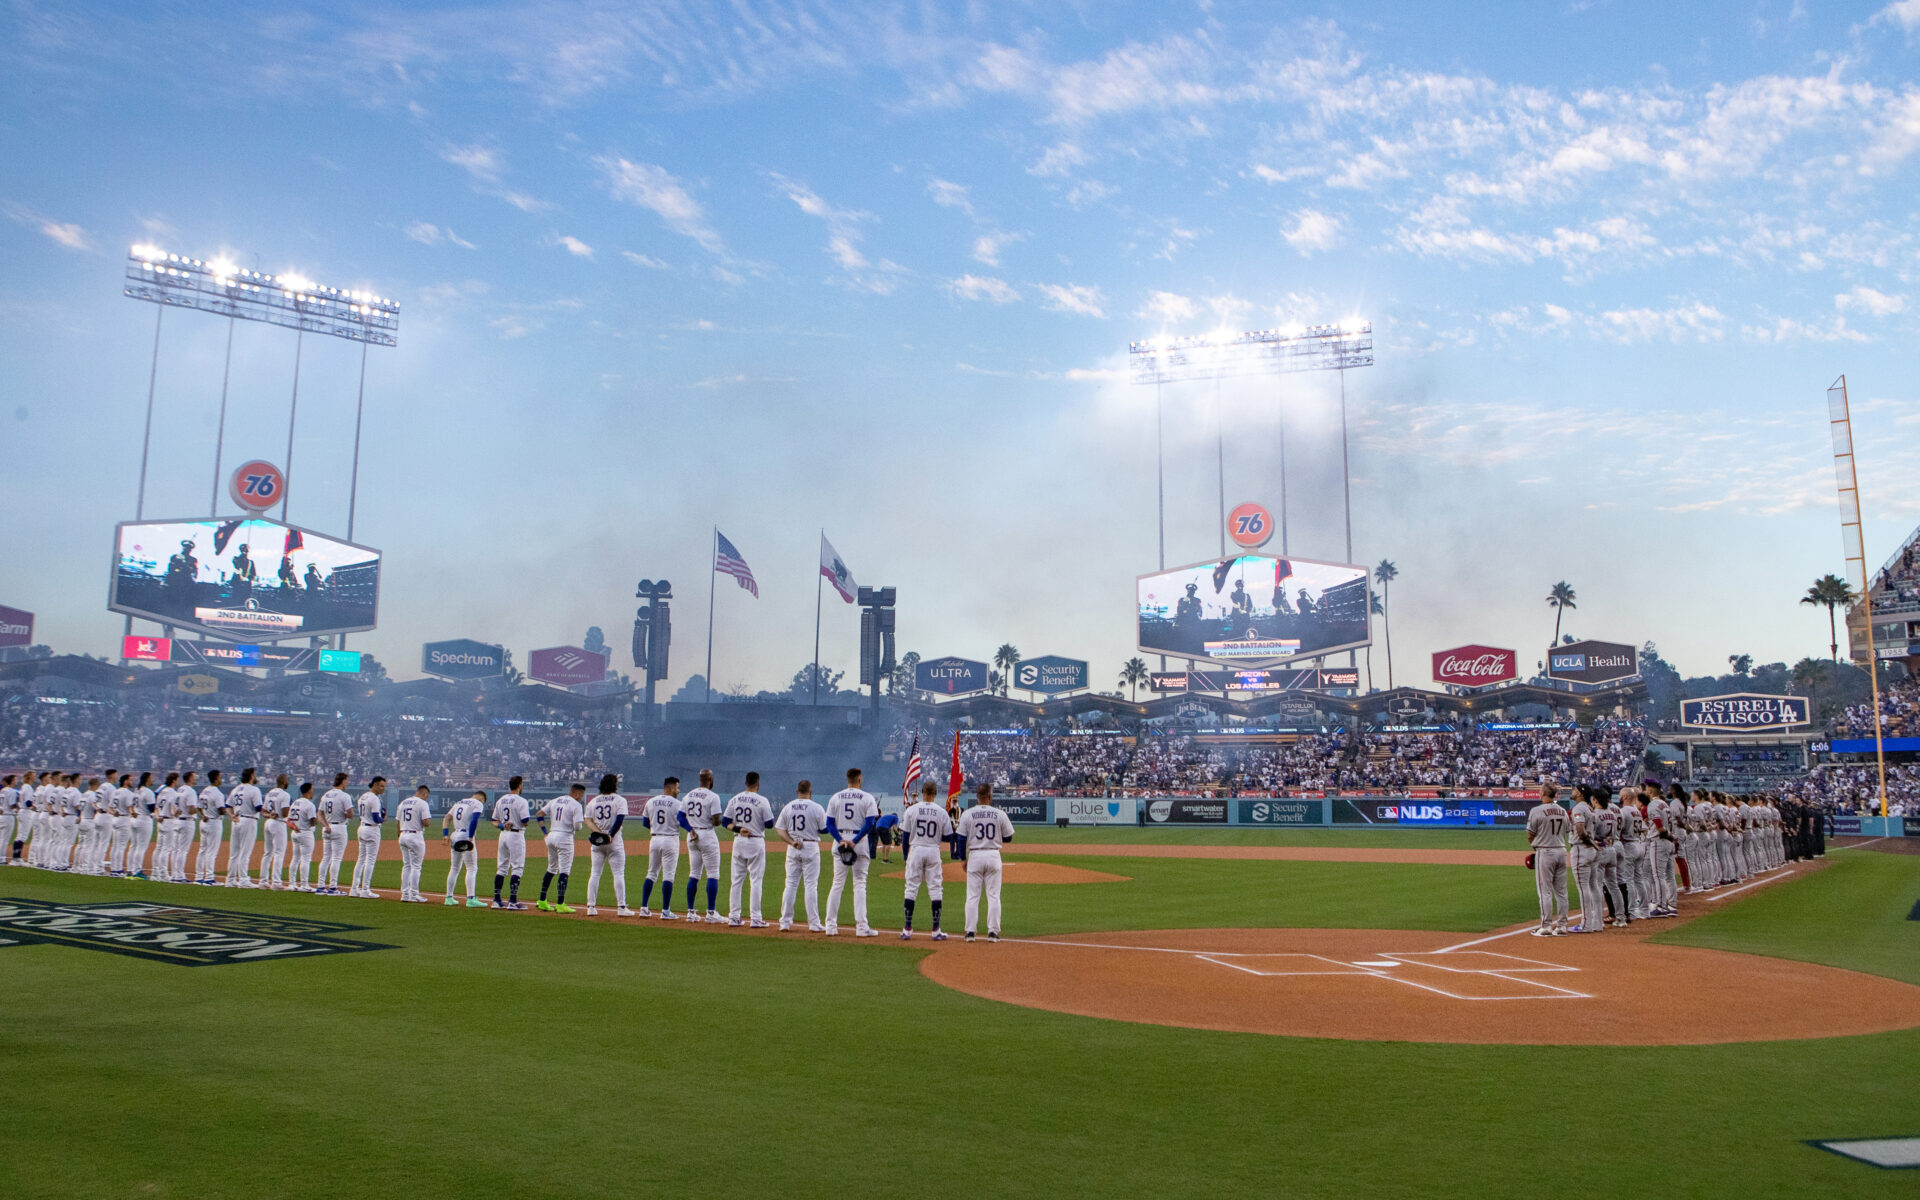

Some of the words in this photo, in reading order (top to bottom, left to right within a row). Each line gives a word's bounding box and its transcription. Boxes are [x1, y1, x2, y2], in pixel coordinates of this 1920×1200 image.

[245, 473, 276, 497] 76
[1236, 512, 1264, 534] 76
[217, 611, 236, 619] 2ND
[237, 612, 284, 623] BATTALION
[1240, 641, 1282, 649] BATTALION
[216, 649, 243, 659] NLDS
[431, 650, 494, 667] Spectrum
[1884, 648, 1903, 657] 1955
[1439, 653, 1509, 677] Coca-Cola
[1554, 657, 1583, 668] UCLA
[1589, 654, 1631, 667] Health
[930, 668, 972, 678] ULTRA
[1041, 664, 1082, 676] Security
[1042, 675, 1076, 686] Benefit
[1693, 712, 1774, 725] JALISCO
[1811, 741, 1830, 752] 6:06
[403, 807, 413, 821] 15
[456, 807, 464, 820] 8
[503, 807, 510, 821] 3
[555, 807, 563, 821] 11
[595, 805, 612, 820] 33
[687, 801, 703, 818] 23
[735, 806, 753, 823] 28
[844, 802, 854, 820] 5
[918, 807, 938, 817] BETTS
[1070, 801, 1104, 815] blue
[1182, 804, 1224, 812] smartwater
[1272, 802, 1309, 813] Security
[1400, 805, 1444, 819] NLDS
[1445, 808, 1478, 817] 2023
[1479, 808, 1526, 818] Booking.com
[656, 809, 666, 824] 6
[971, 810, 998, 820] ROBERTS
[1273, 812, 1304, 822] Benefit
[792, 814, 806, 831] 13
[916, 819, 937, 838] 50
[1550, 818, 1563, 835] 17
[1606, 822, 1613, 837] 7
[975, 823, 996, 840] 30
[151, 912, 324, 935] 2023
[0, 904, 334, 959] STSEASON
